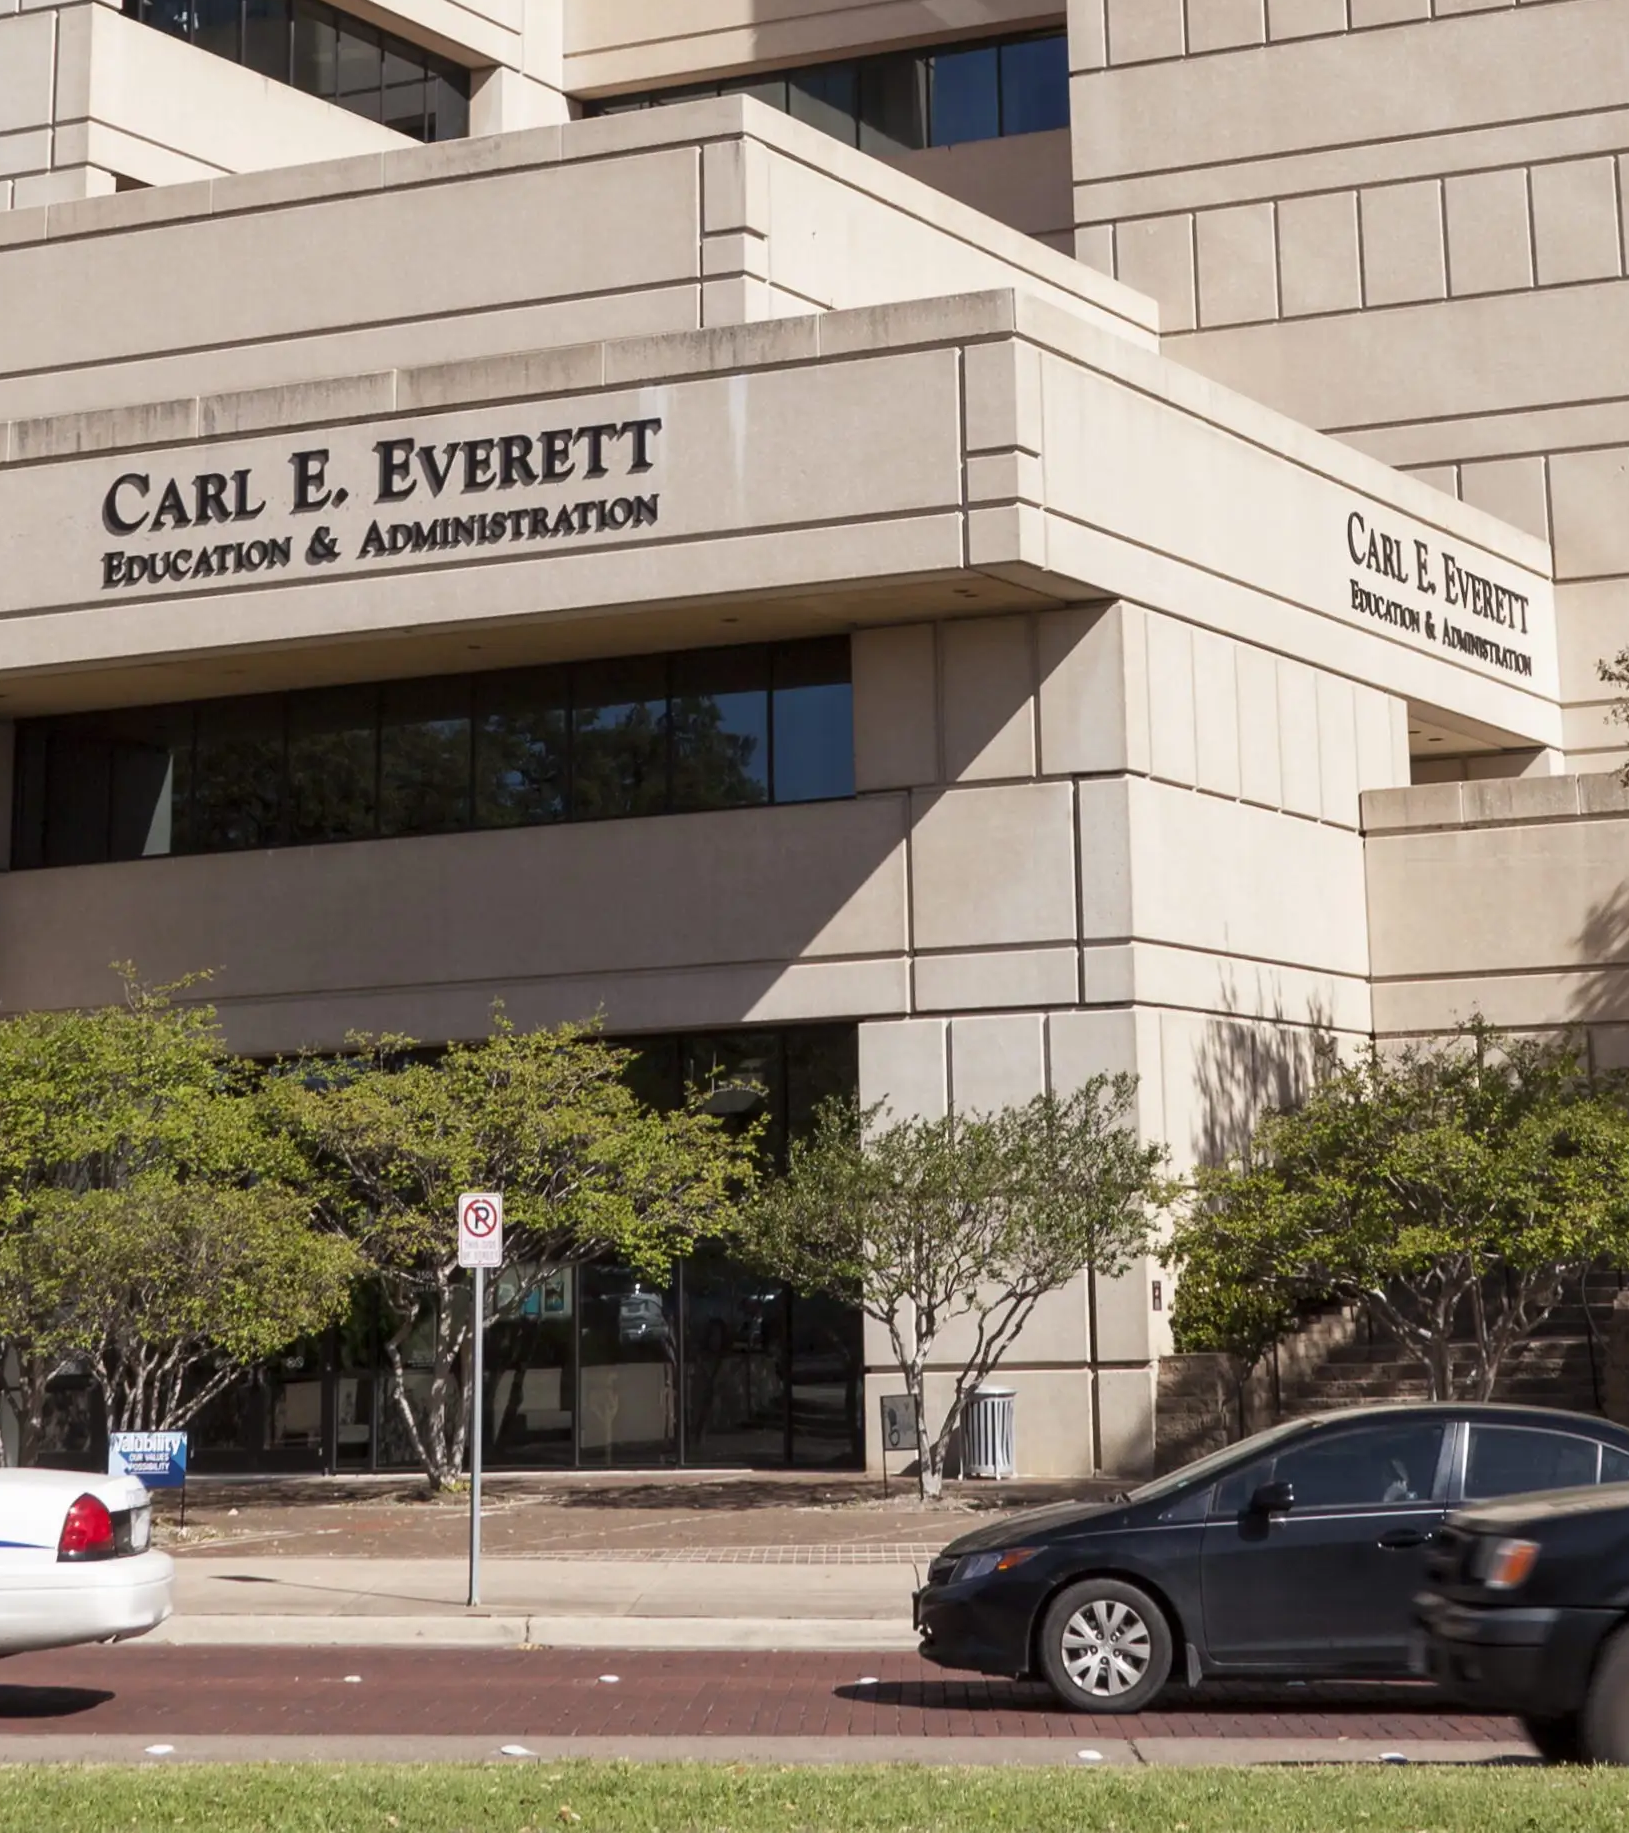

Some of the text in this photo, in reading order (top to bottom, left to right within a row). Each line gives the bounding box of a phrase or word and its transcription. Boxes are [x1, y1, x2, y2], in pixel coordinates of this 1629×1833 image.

[289, 448, 350, 515] E.
[305, 525, 339, 563] &
[1413, 539, 1437, 595] E.
[1424, 610, 1437, 641] &
